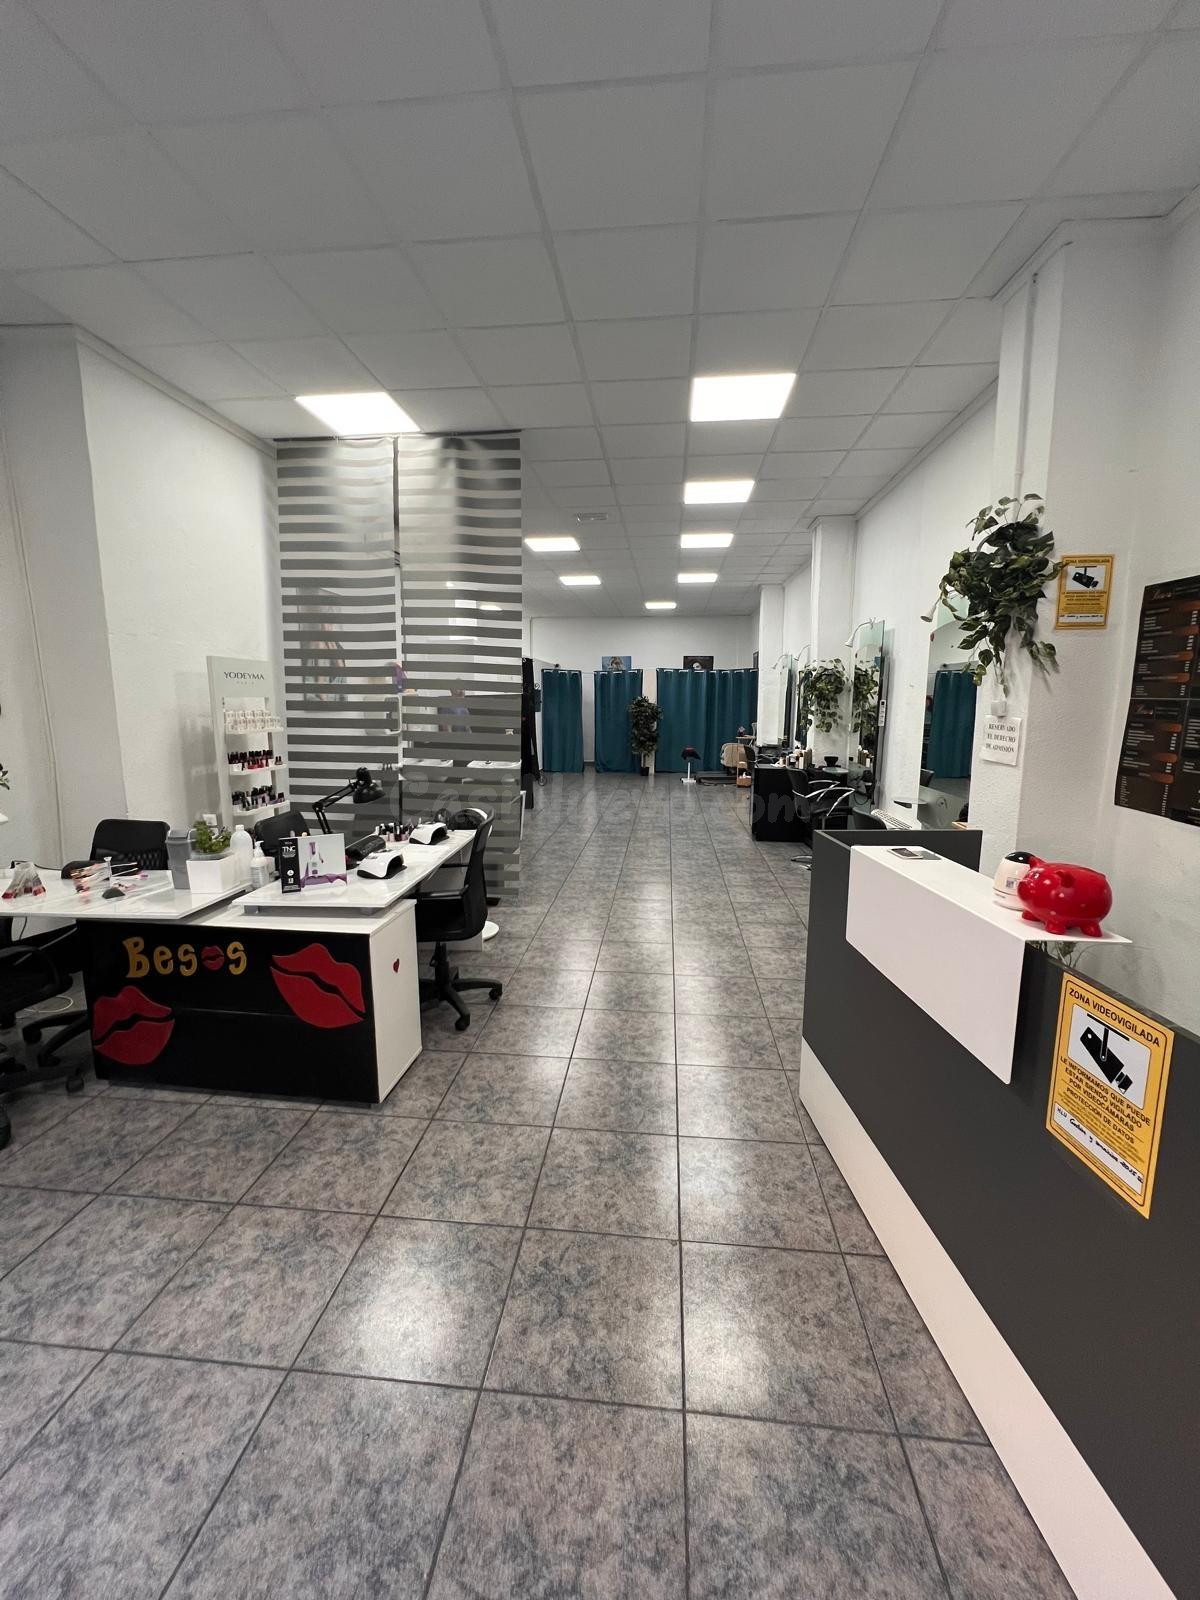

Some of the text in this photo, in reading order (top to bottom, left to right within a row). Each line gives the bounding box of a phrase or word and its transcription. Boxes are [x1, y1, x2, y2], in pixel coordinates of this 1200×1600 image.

[223, 671, 265, 680] YODEYMA
[1069, 987, 1160, 1047] ZONA VIDEOVIGILADA
[1060, 1055, 1151, 1127] LE INFORMAMOS QUE PUEDE
[1064, 1067, 1142, 1129] ESTAR SIENDO VIGILADO
[1068, 1078, 1082, 1091] POR
[1103, 1115, 1112, 1127] DE
[1112, 1123, 1135, 1144] DATOS
